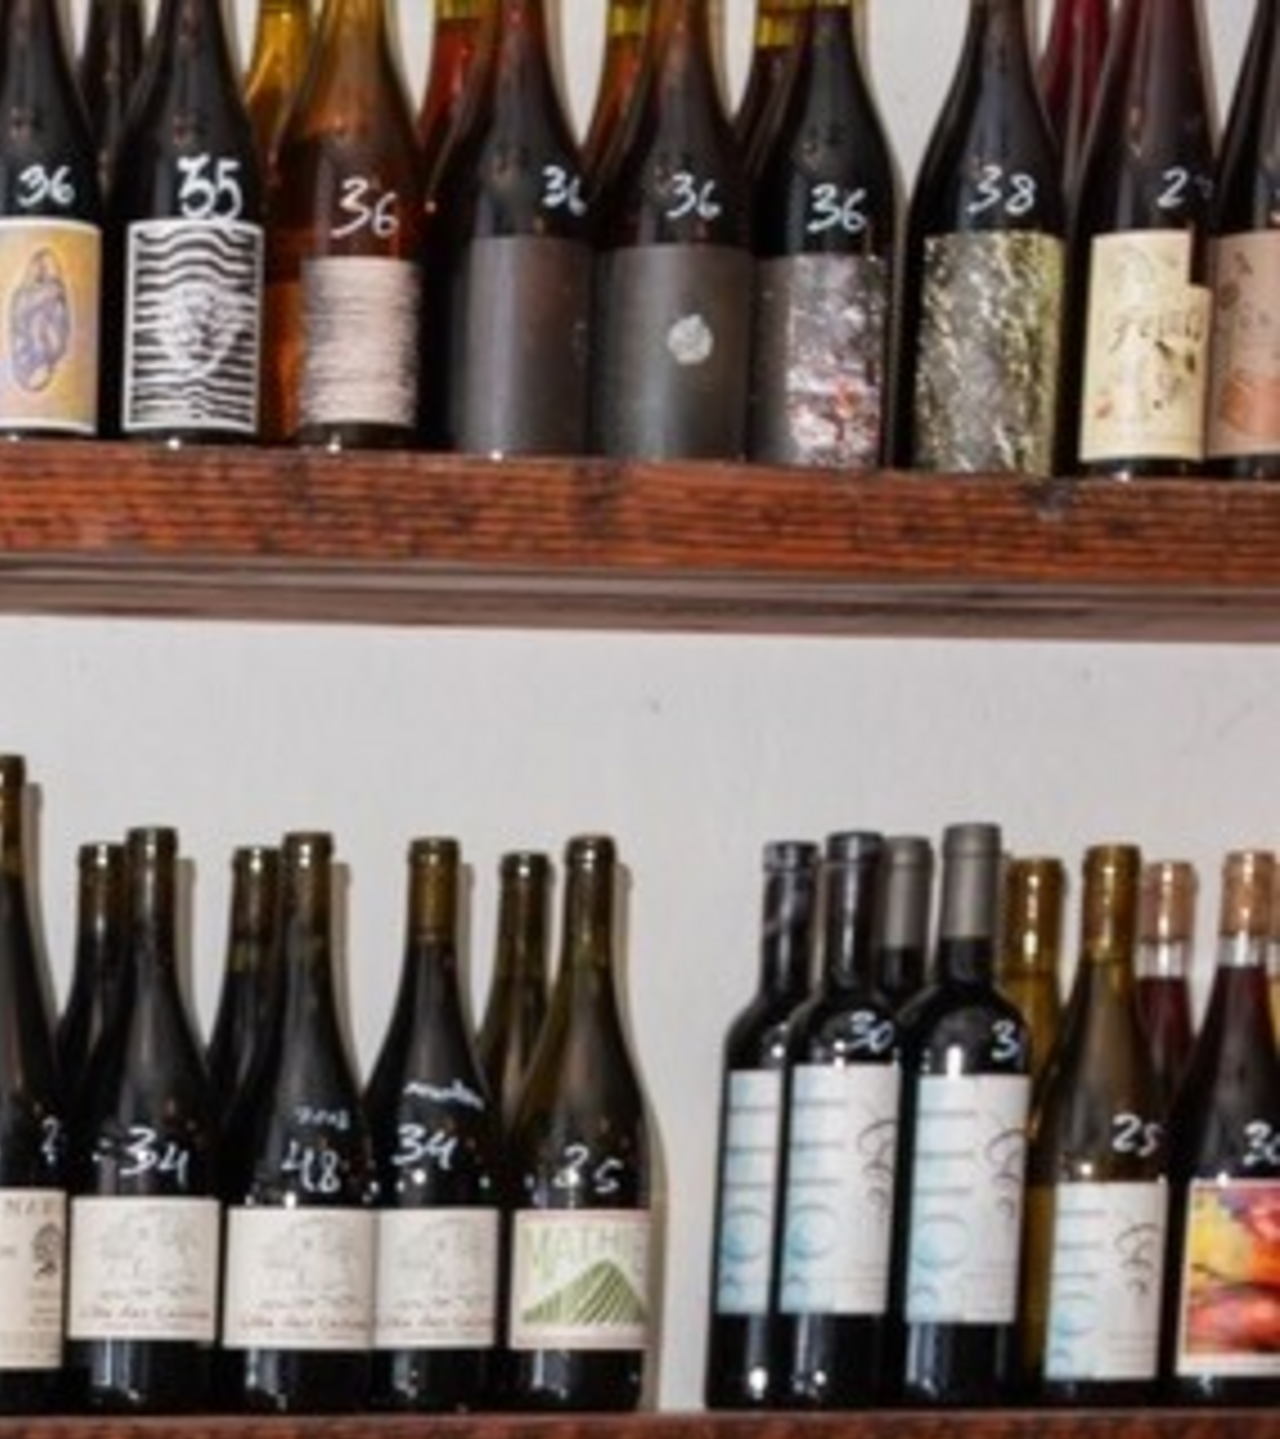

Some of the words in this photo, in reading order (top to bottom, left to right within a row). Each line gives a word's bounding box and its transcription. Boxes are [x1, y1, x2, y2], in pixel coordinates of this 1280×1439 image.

[17, 164, 75, 207] 36
[176, 154, 244, 221] 35
[330, 176, 399, 238] 36
[666, 173, 722, 218] 36
[806, 182, 867, 233] 36
[967, 165, 1036, 215] 38
[991, 1019, 1020, 1060] 3
[120, 1128, 189, 1184] 34
[392, 1122, 457, 1171] 34
